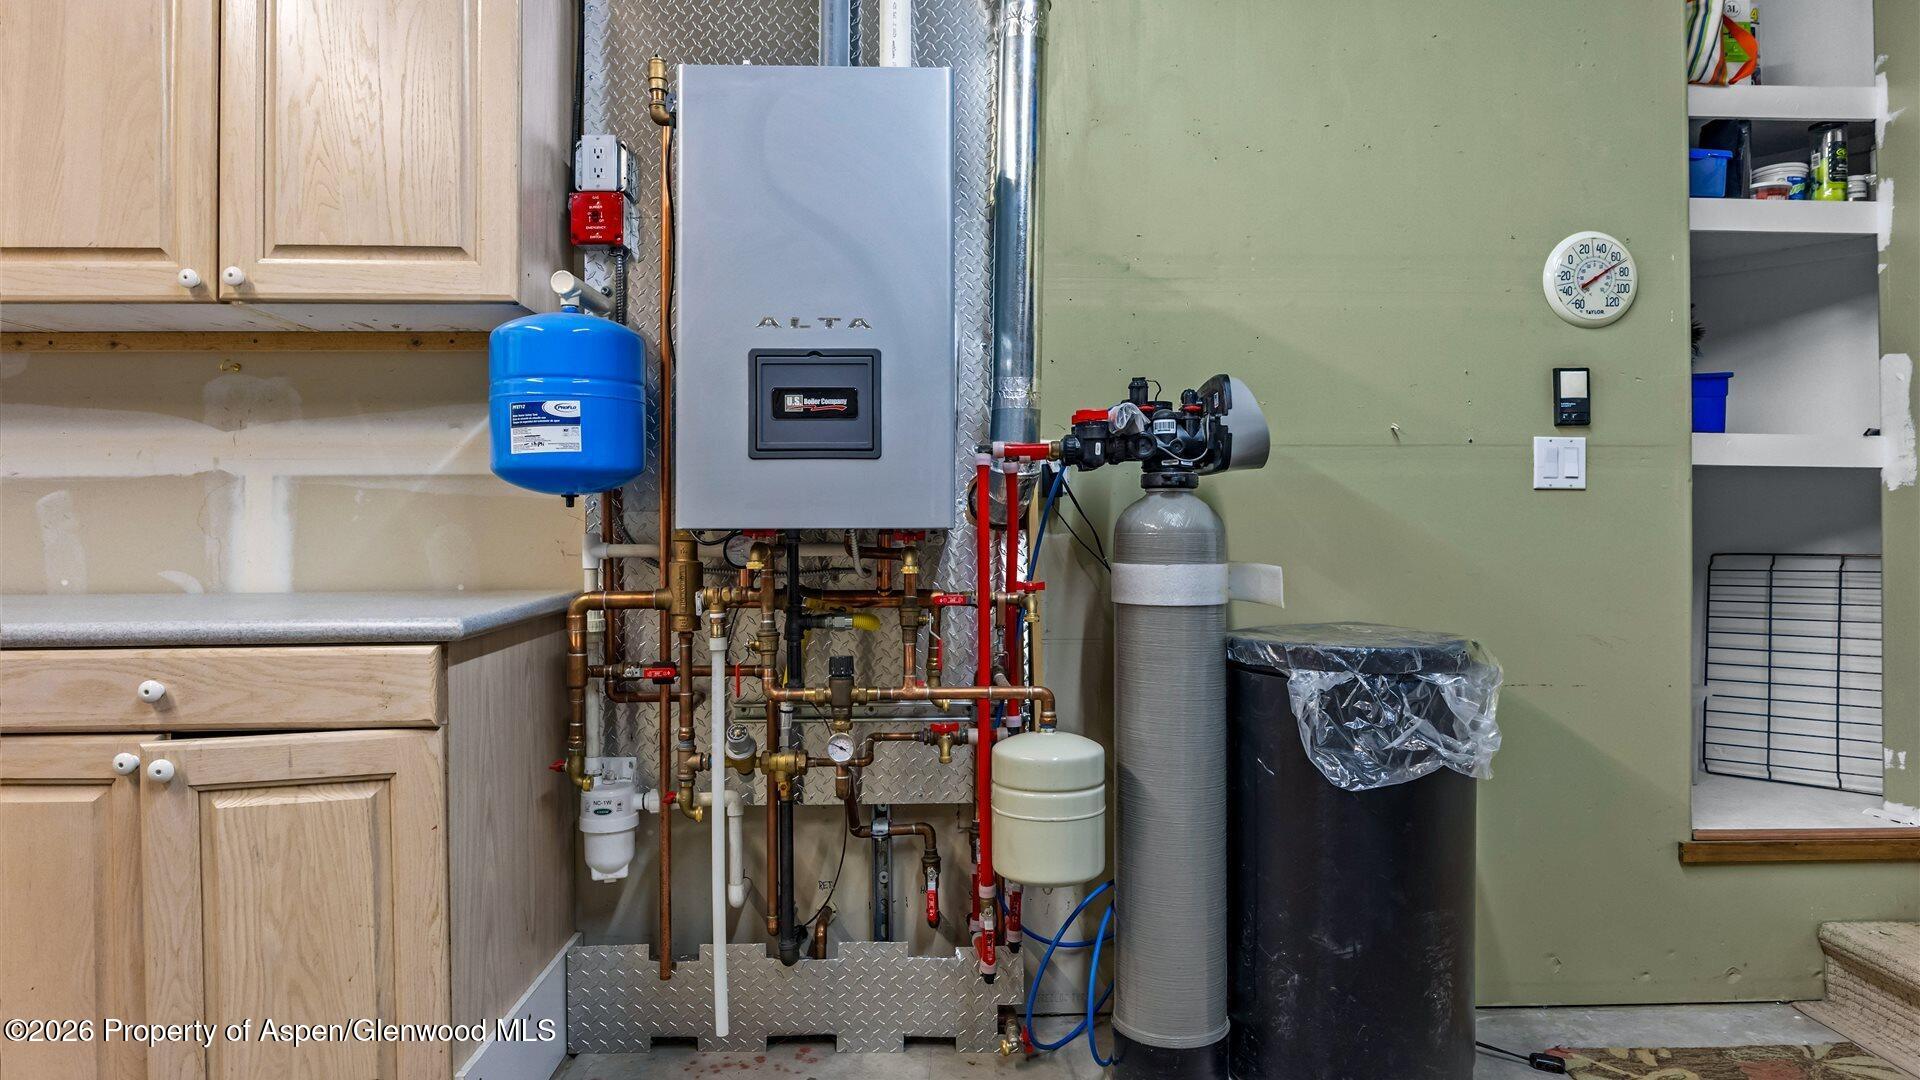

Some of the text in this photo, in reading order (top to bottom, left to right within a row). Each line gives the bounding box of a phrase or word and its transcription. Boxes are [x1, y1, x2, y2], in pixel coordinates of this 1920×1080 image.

[1579, 244, 1590, 254] 20
[1596, 243, 1606, 253] 40
[1568, 255, 1573, 264] 0
[1611, 252, 1621, 261] 60
[1619, 267, 1629, 277] 80
[1617, 283, 1630, 293] 100
[1605, 297, 1619, 307] 120
[755, 317, 872, 329] ALTA
[786, 396, 803, 405] U.S.
[821, 398, 848, 406] Company
